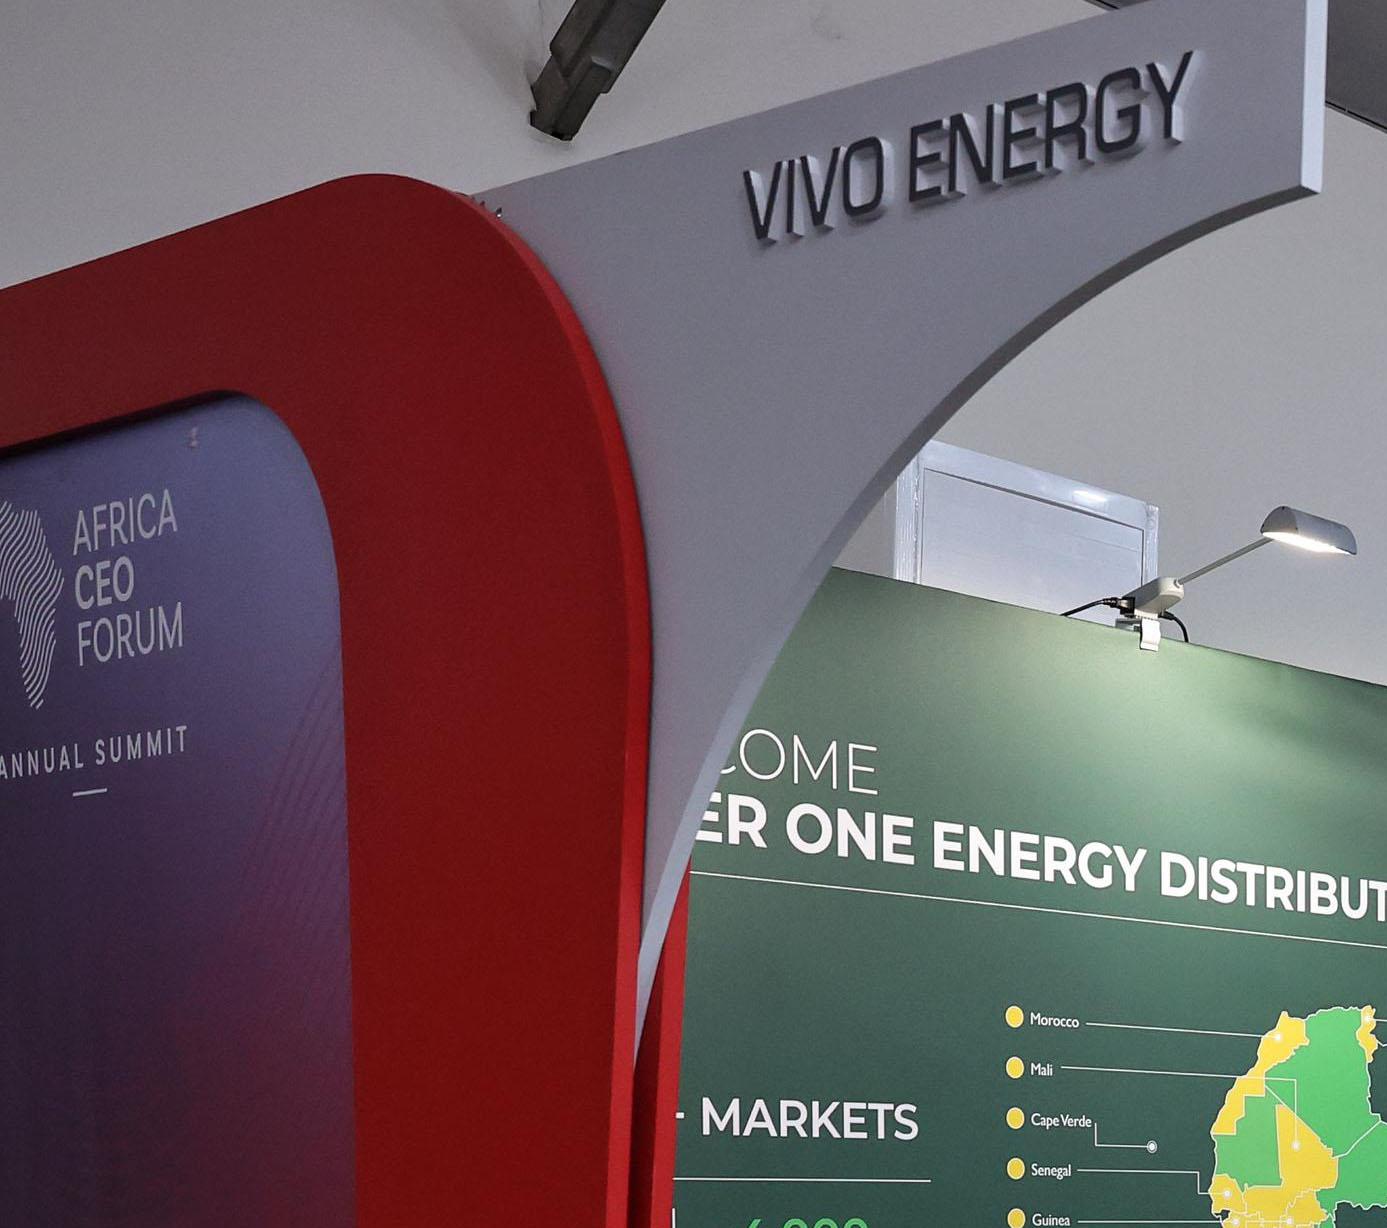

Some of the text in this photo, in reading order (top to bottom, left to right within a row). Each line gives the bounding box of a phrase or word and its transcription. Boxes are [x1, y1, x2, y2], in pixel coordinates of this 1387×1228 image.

[743, 50, 1196, 243] VIVO ENERGY
[73, 488, 178, 555] AFRICA
[75, 556, 134, 609] CEO
[78, 601, 184, 666] FORUM
[95, 725, 187, 765] SUMMIT
[720, 728, 879, 795] OME
[785, 803, 915, 866] ONE
[933, 820, 1148, 893] ENERGY
[1030, 1011, 1080, 1028] Morocco
[1030, 1063, 1053, 1076] Mali
[702, 1096, 919, 1141] MARKETS
[1031, 1112, 1092, 1130] Cape Verde
[1031, 1163, 1072, 1181] Senegal
[1032, 1213, 1070, 1226] Guinea
